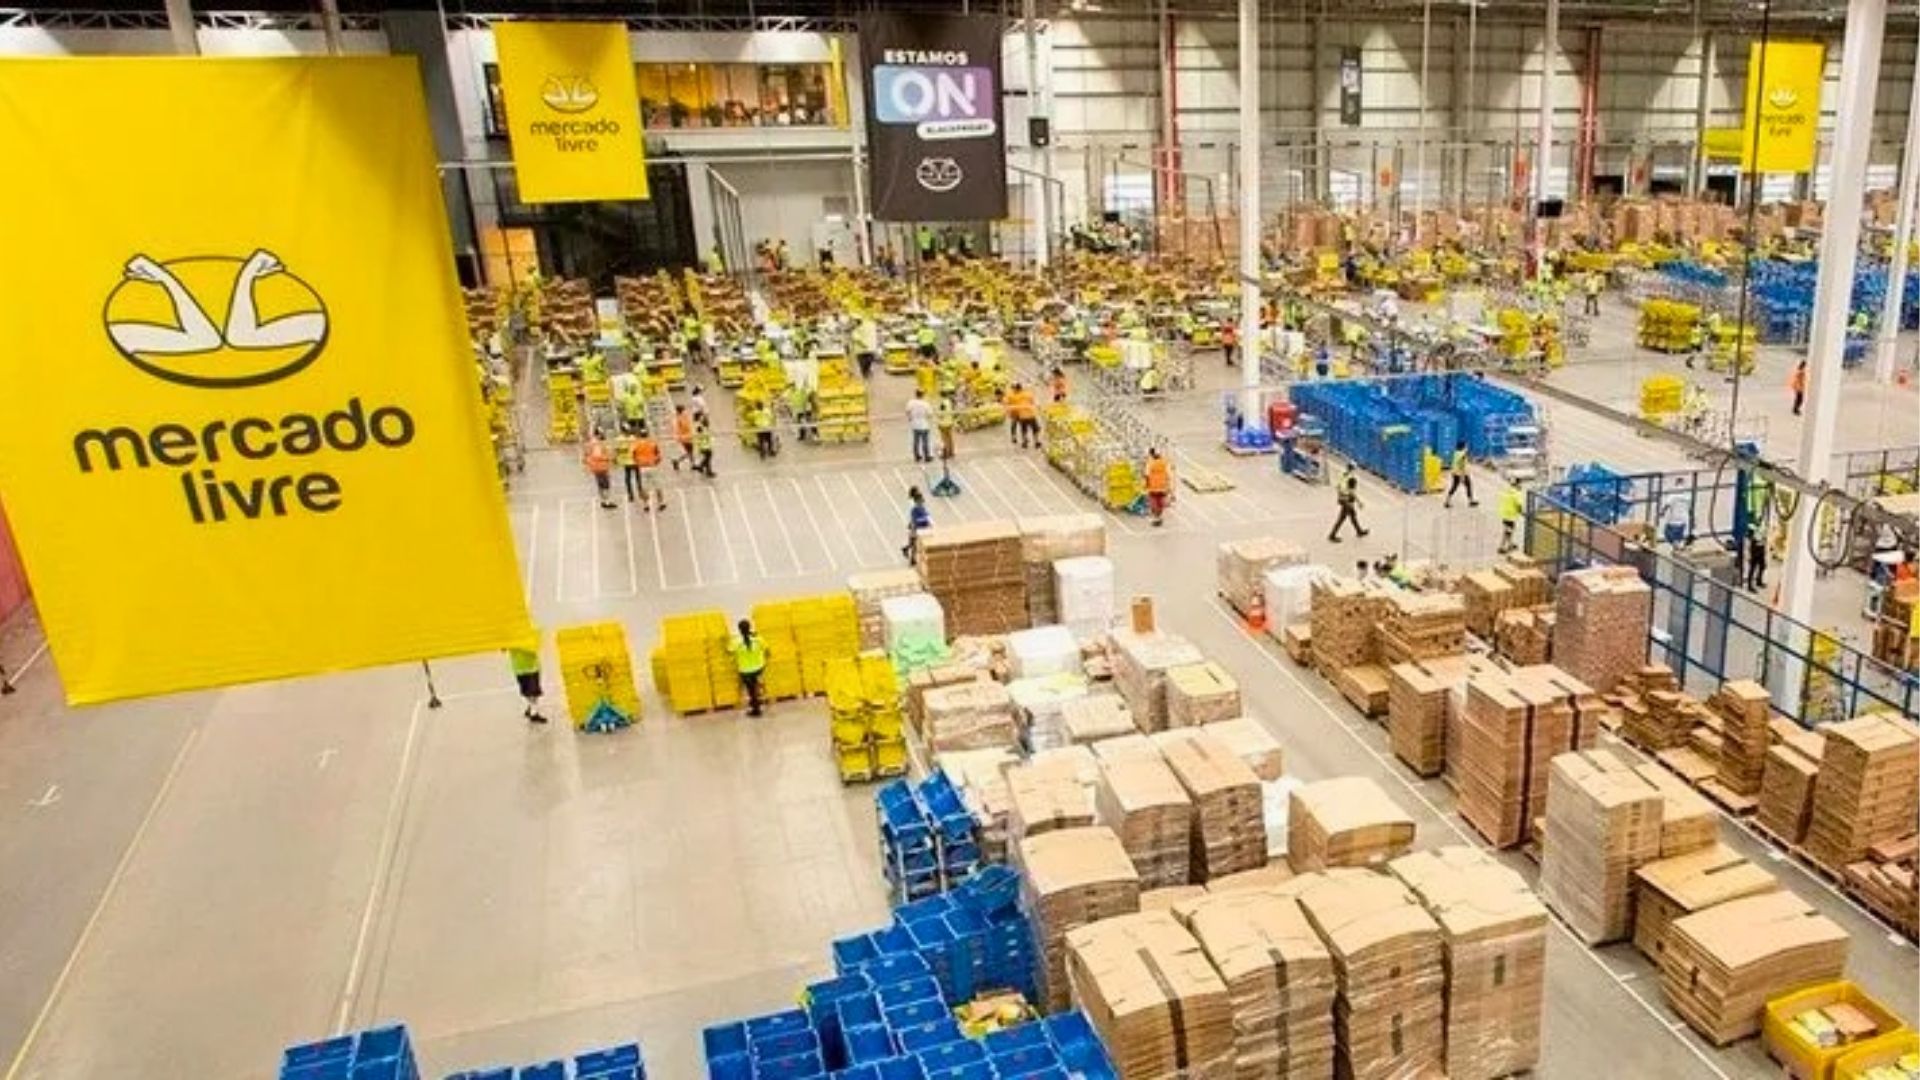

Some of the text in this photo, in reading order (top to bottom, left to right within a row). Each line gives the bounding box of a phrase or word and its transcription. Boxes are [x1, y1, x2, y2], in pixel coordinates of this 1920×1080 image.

[884, 49, 968, 65] ESTAMOS
[891, 71, 977, 117] ON
[530, 118, 620, 135] mercado
[555, 137, 599, 152] livre
[73, 397, 415, 473] mercado
[181, 469, 342, 524] livre
